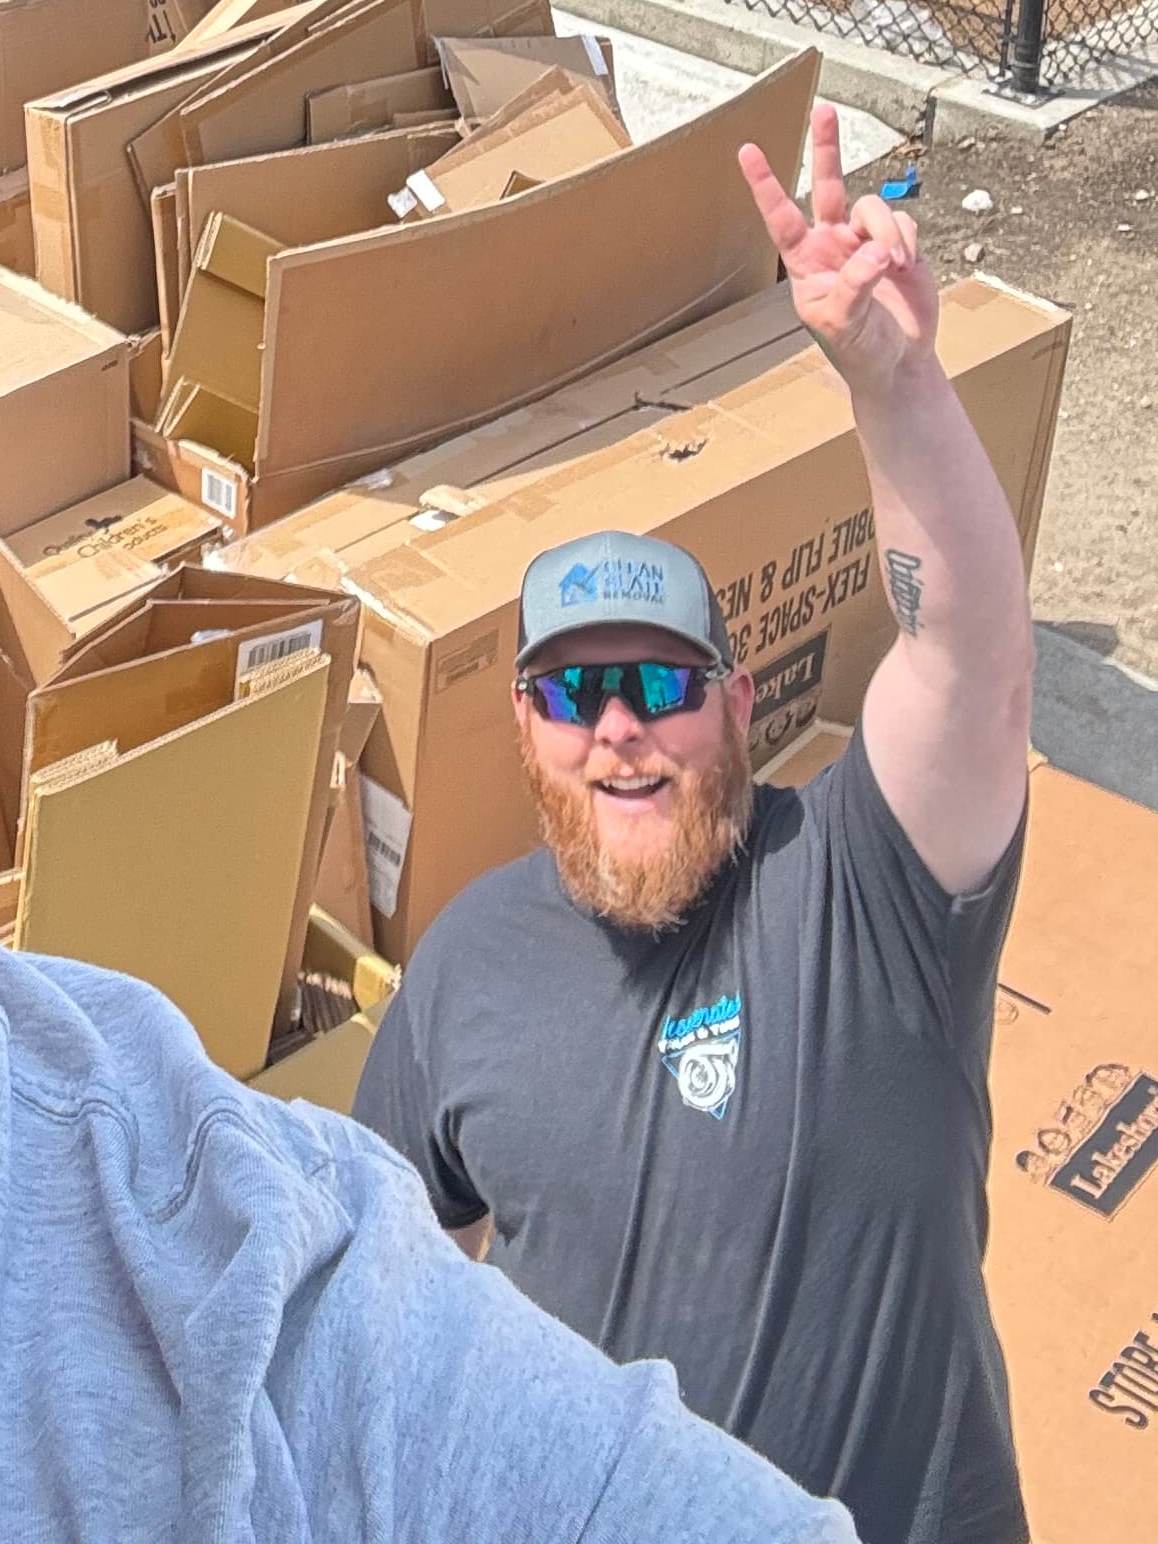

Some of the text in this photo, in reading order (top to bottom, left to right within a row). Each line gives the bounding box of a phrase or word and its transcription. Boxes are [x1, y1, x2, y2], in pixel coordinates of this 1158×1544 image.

[77, 517, 158, 559] Children's
[782, 533, 826, 592] FLIP
[755, 553, 871, 654] FLEX-SPACE
[760, 560, 778, 603] &
